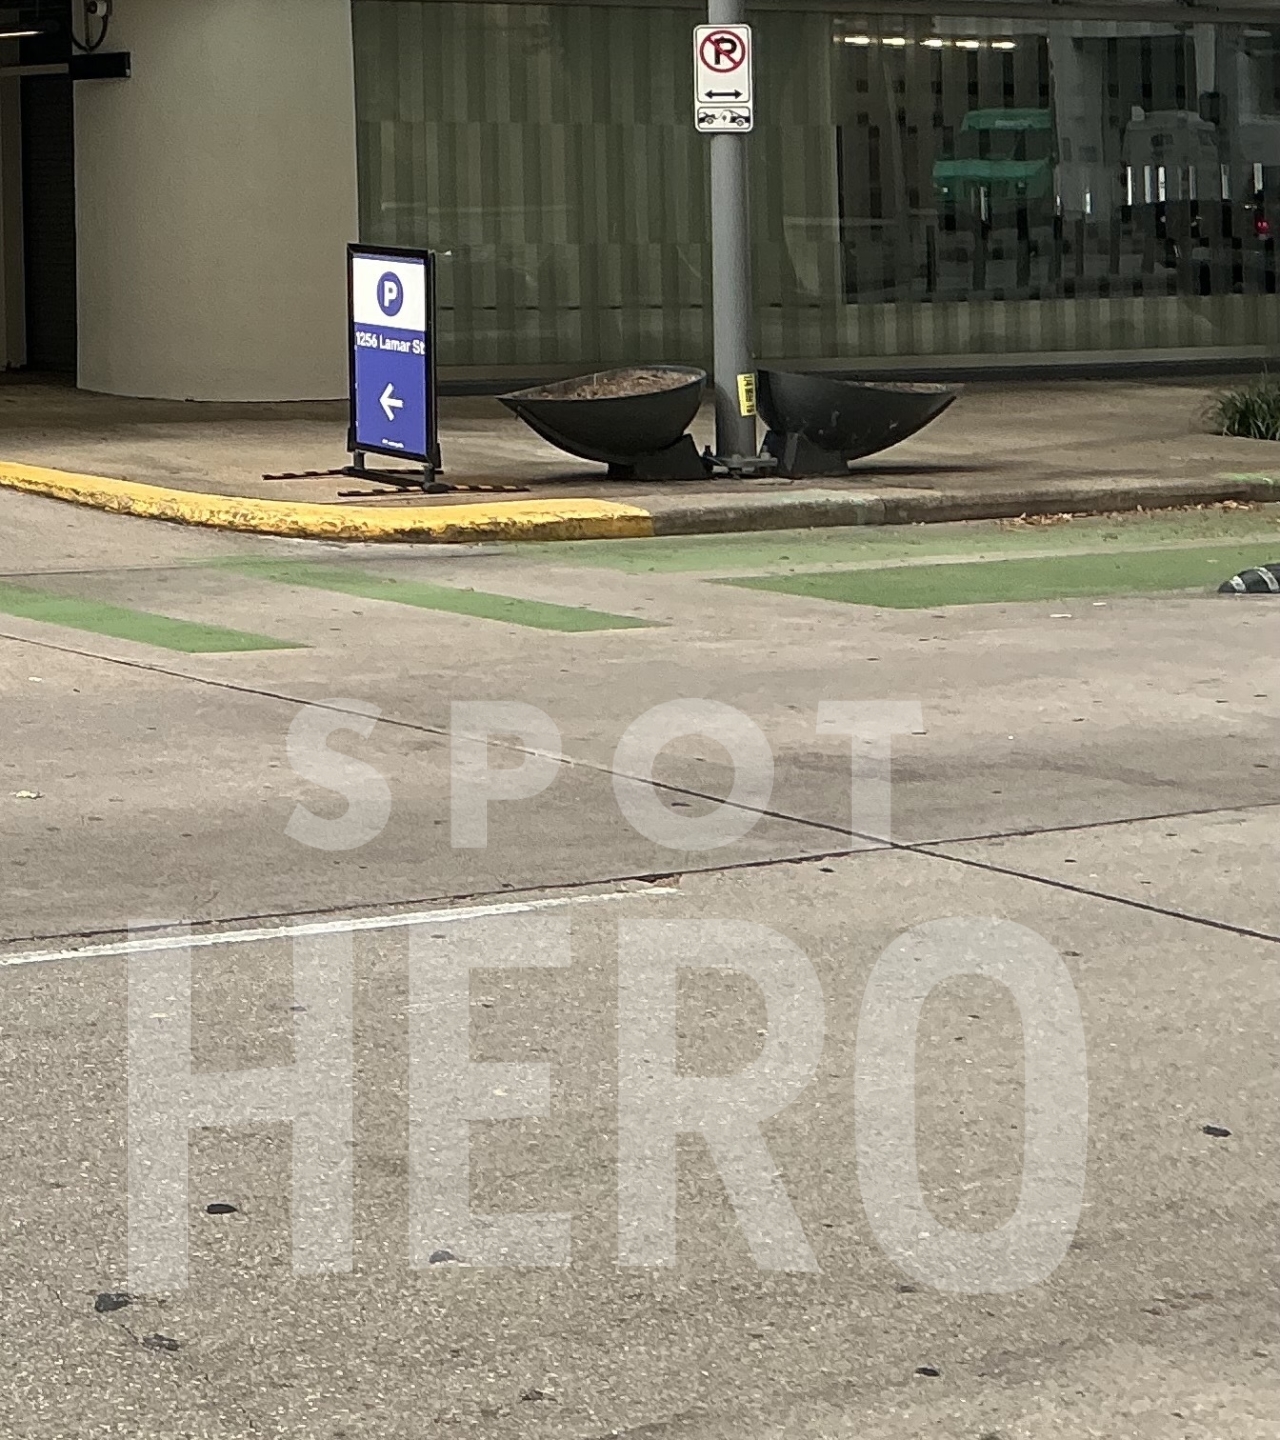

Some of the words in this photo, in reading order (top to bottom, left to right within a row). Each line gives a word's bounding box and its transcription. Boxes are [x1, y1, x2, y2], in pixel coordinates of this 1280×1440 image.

[384, 280, 398, 307] P
[355, 330, 378, 349] 1256
[379, 333, 411, 353] Lamar
[412, 339, 426, 356] St
